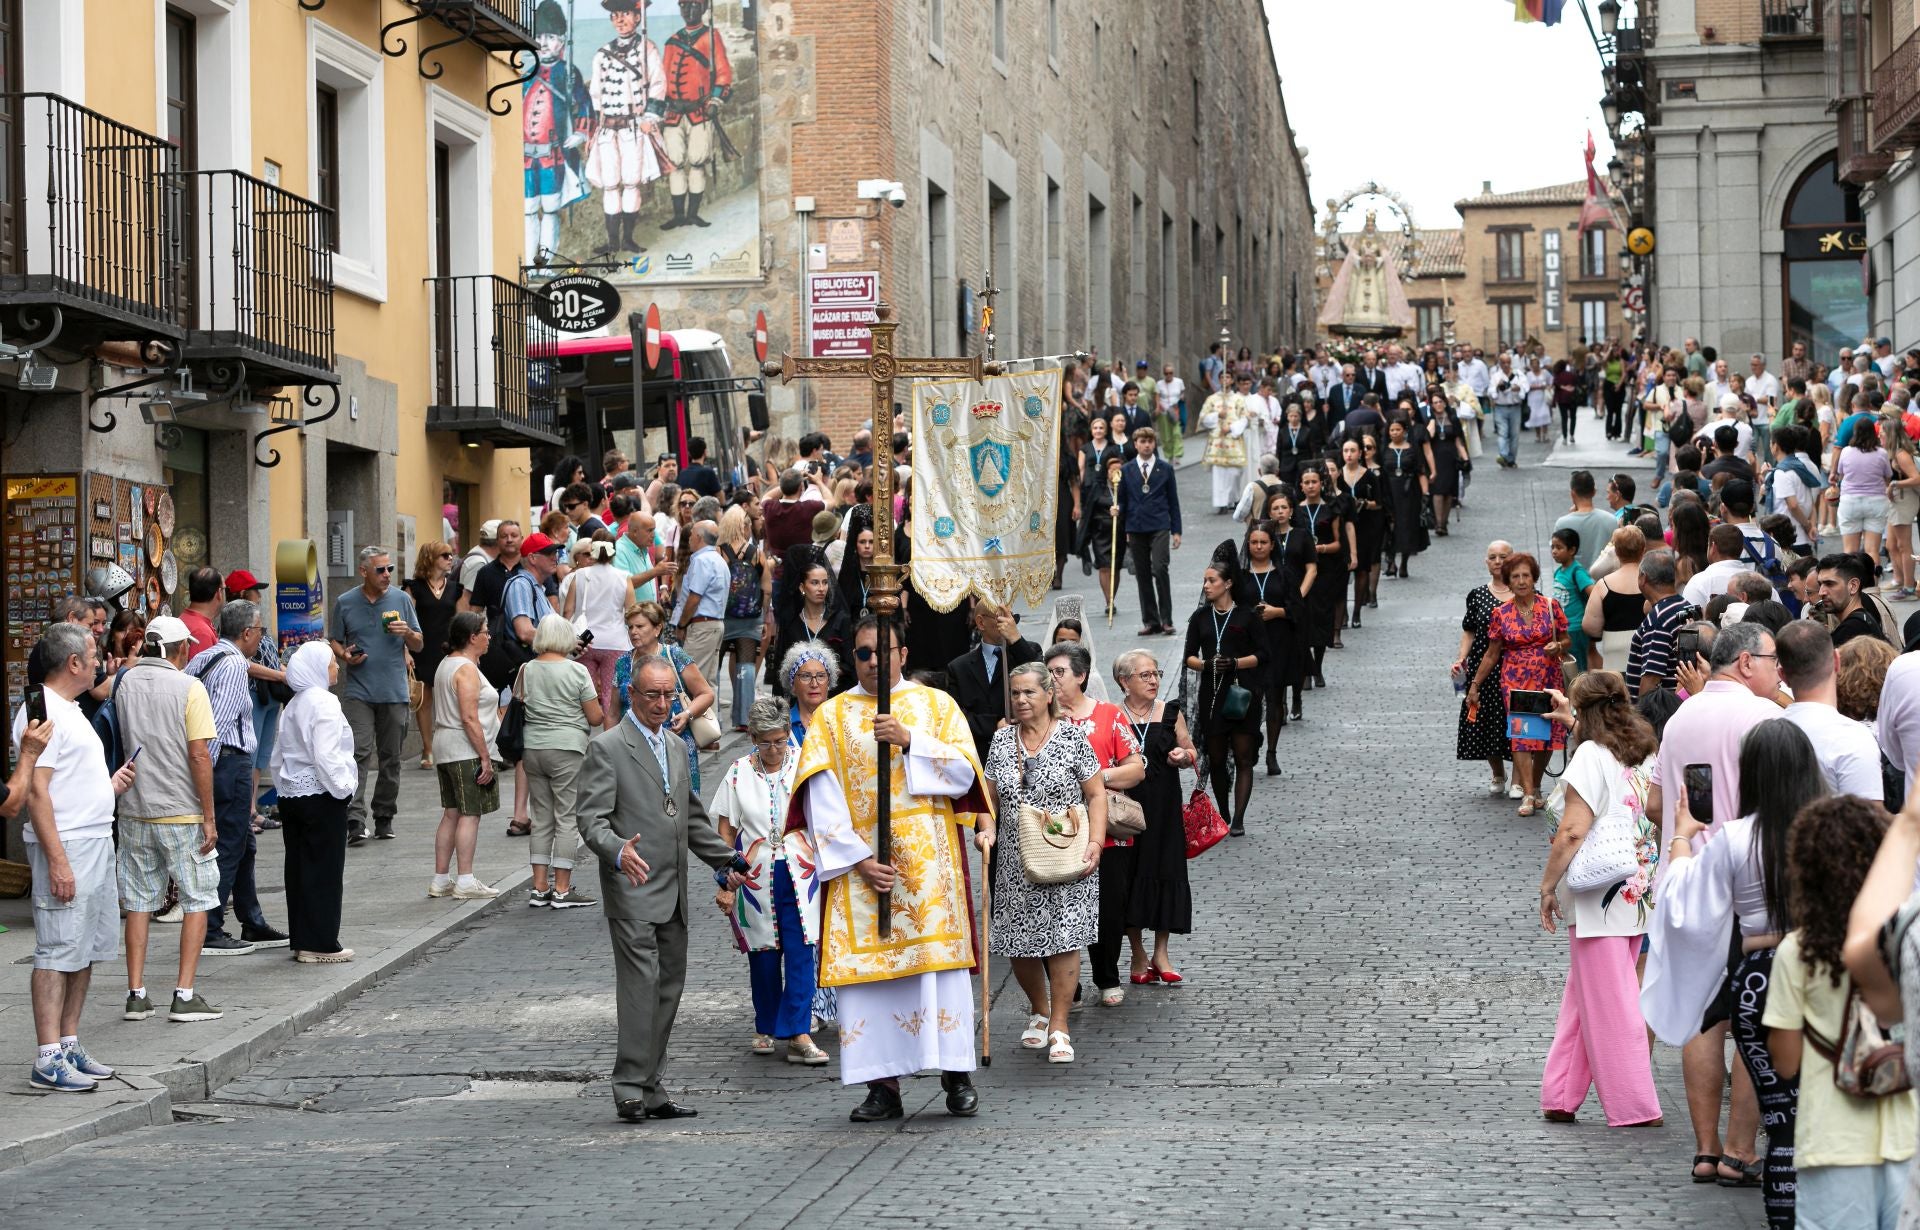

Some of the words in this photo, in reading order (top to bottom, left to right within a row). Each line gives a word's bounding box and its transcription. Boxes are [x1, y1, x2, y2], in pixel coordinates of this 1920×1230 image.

[550, 277, 601, 290] RESTAURANTE
[814, 278, 865, 290] BIBLIOTECA
[1545, 233, 1560, 325] HOTEL
[582, 308, 605, 319] ALCÁZAR
[813, 310, 840, 322] ALCÁZAR
[841, 311, 850, 322] DE
[851, 311, 874, 322] TOLEDO
[560, 318, 597, 330] TAPAS
[813, 328, 834, 340] MUSEO
[834, 328, 846, 339] DEL
[847, 326, 872, 339] EJÉRCIT
[281, 602, 306, 610] TOLEDO
[1739, 971, 1768, 1039] Calvin
[1744, 1041, 1779, 1086] Klein
[1762, 1109, 1788, 1126] ein
